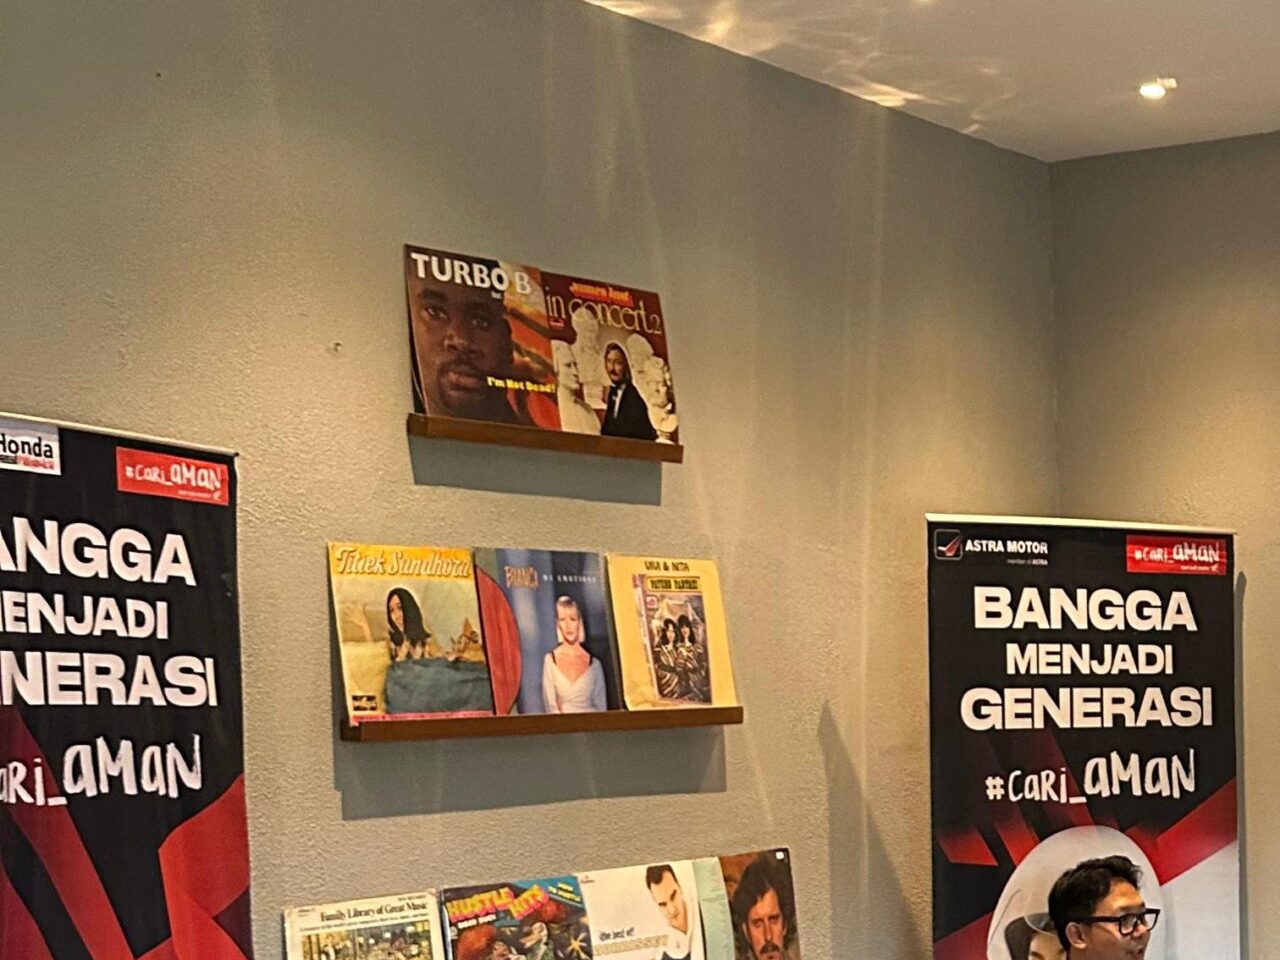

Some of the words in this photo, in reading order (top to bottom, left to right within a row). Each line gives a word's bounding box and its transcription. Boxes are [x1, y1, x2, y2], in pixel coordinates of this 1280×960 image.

[410, 252, 508, 291] TURBO
[516, 271, 531, 295] B
[546, 286, 567, 319] in
[568, 298, 652, 333] concert
[965, 539, 1004, 552] ASTRA
[1006, 540, 1049, 554] MOTOR
[0, 590, 168, 639] ENJADI
[973, 586, 1198, 631] BANGGA
[0, 650, 217, 706] NERASI
[1005, 643, 1174, 675] MENJADI
[960, 686, 1213, 731] GENERASI
